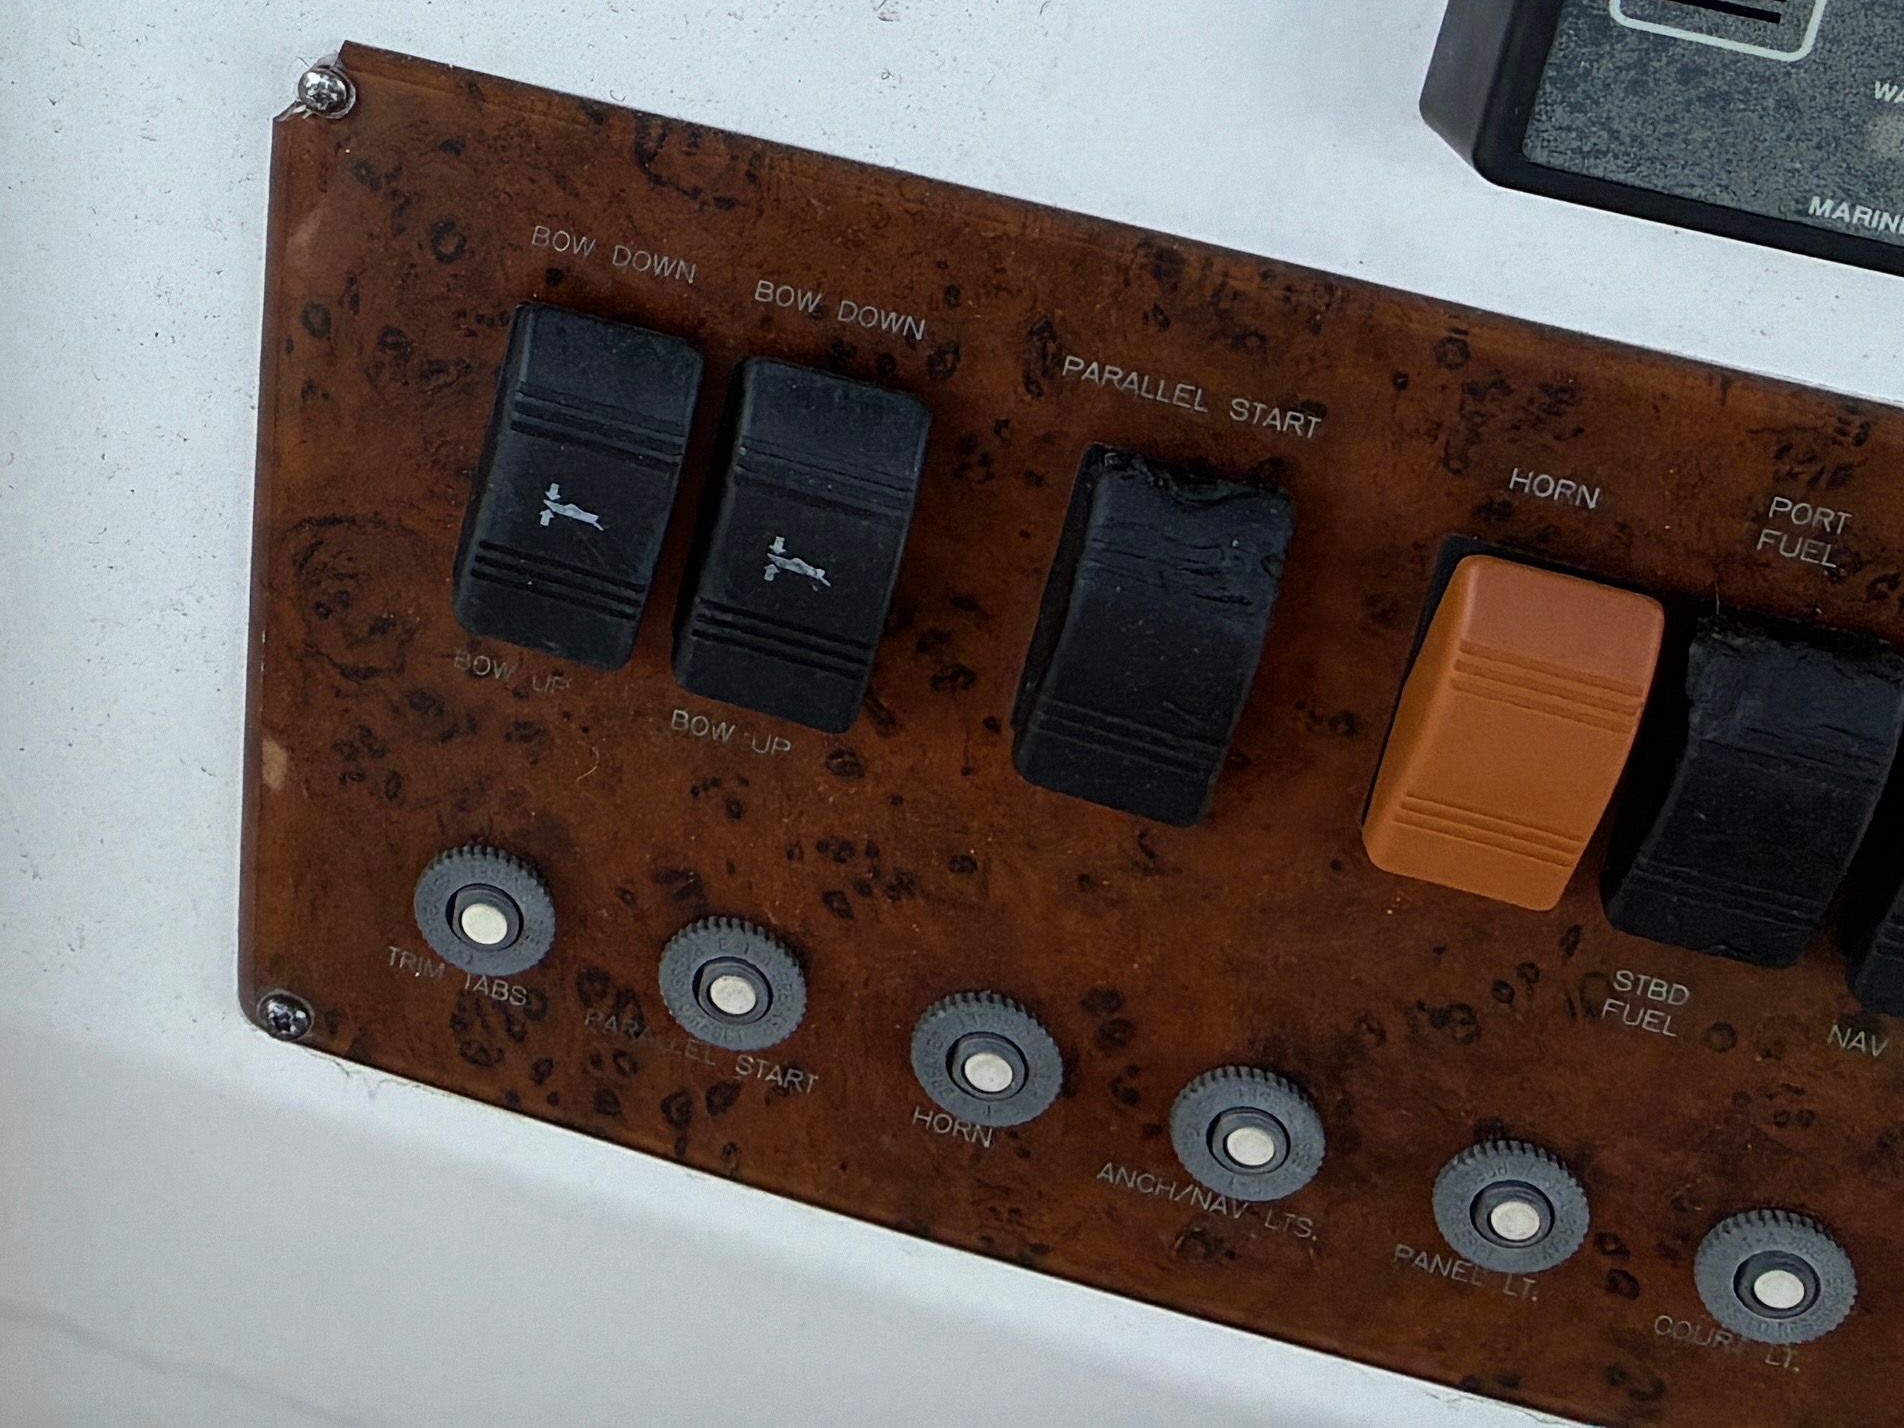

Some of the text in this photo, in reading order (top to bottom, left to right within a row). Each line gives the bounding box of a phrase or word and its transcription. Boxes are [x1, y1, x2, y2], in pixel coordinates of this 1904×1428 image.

[1808, 196, 1904, 234] MARIN
[531, 225, 697, 284] BOW DOWN
[755, 280, 926, 341] BOW DOWN
[1062, 355, 1323, 440] PARALLEL START
[1508, 467, 1600, 510] HORN
[1768, 496, 1852, 535] PORT
[1756, 529, 1838, 569] FUEL
[453, 651, 571, 695] BOW UP
[671, 709, 791, 756] BOW UP
[388, 946, 446, 979] TRIM
[1612, 970, 1690, 1007] STBD
[1601, 998, 1678, 1037] FUEL
[1827, 1024, 1889, 1057] NAV
[735, 1055, 818, 1094] START
[912, 1106, 992, 1148] HORN
[1096, 1162, 1318, 1241] ANCH/NAV LTS.
[1393, 1243, 1537, 1302] PANEL LT.
